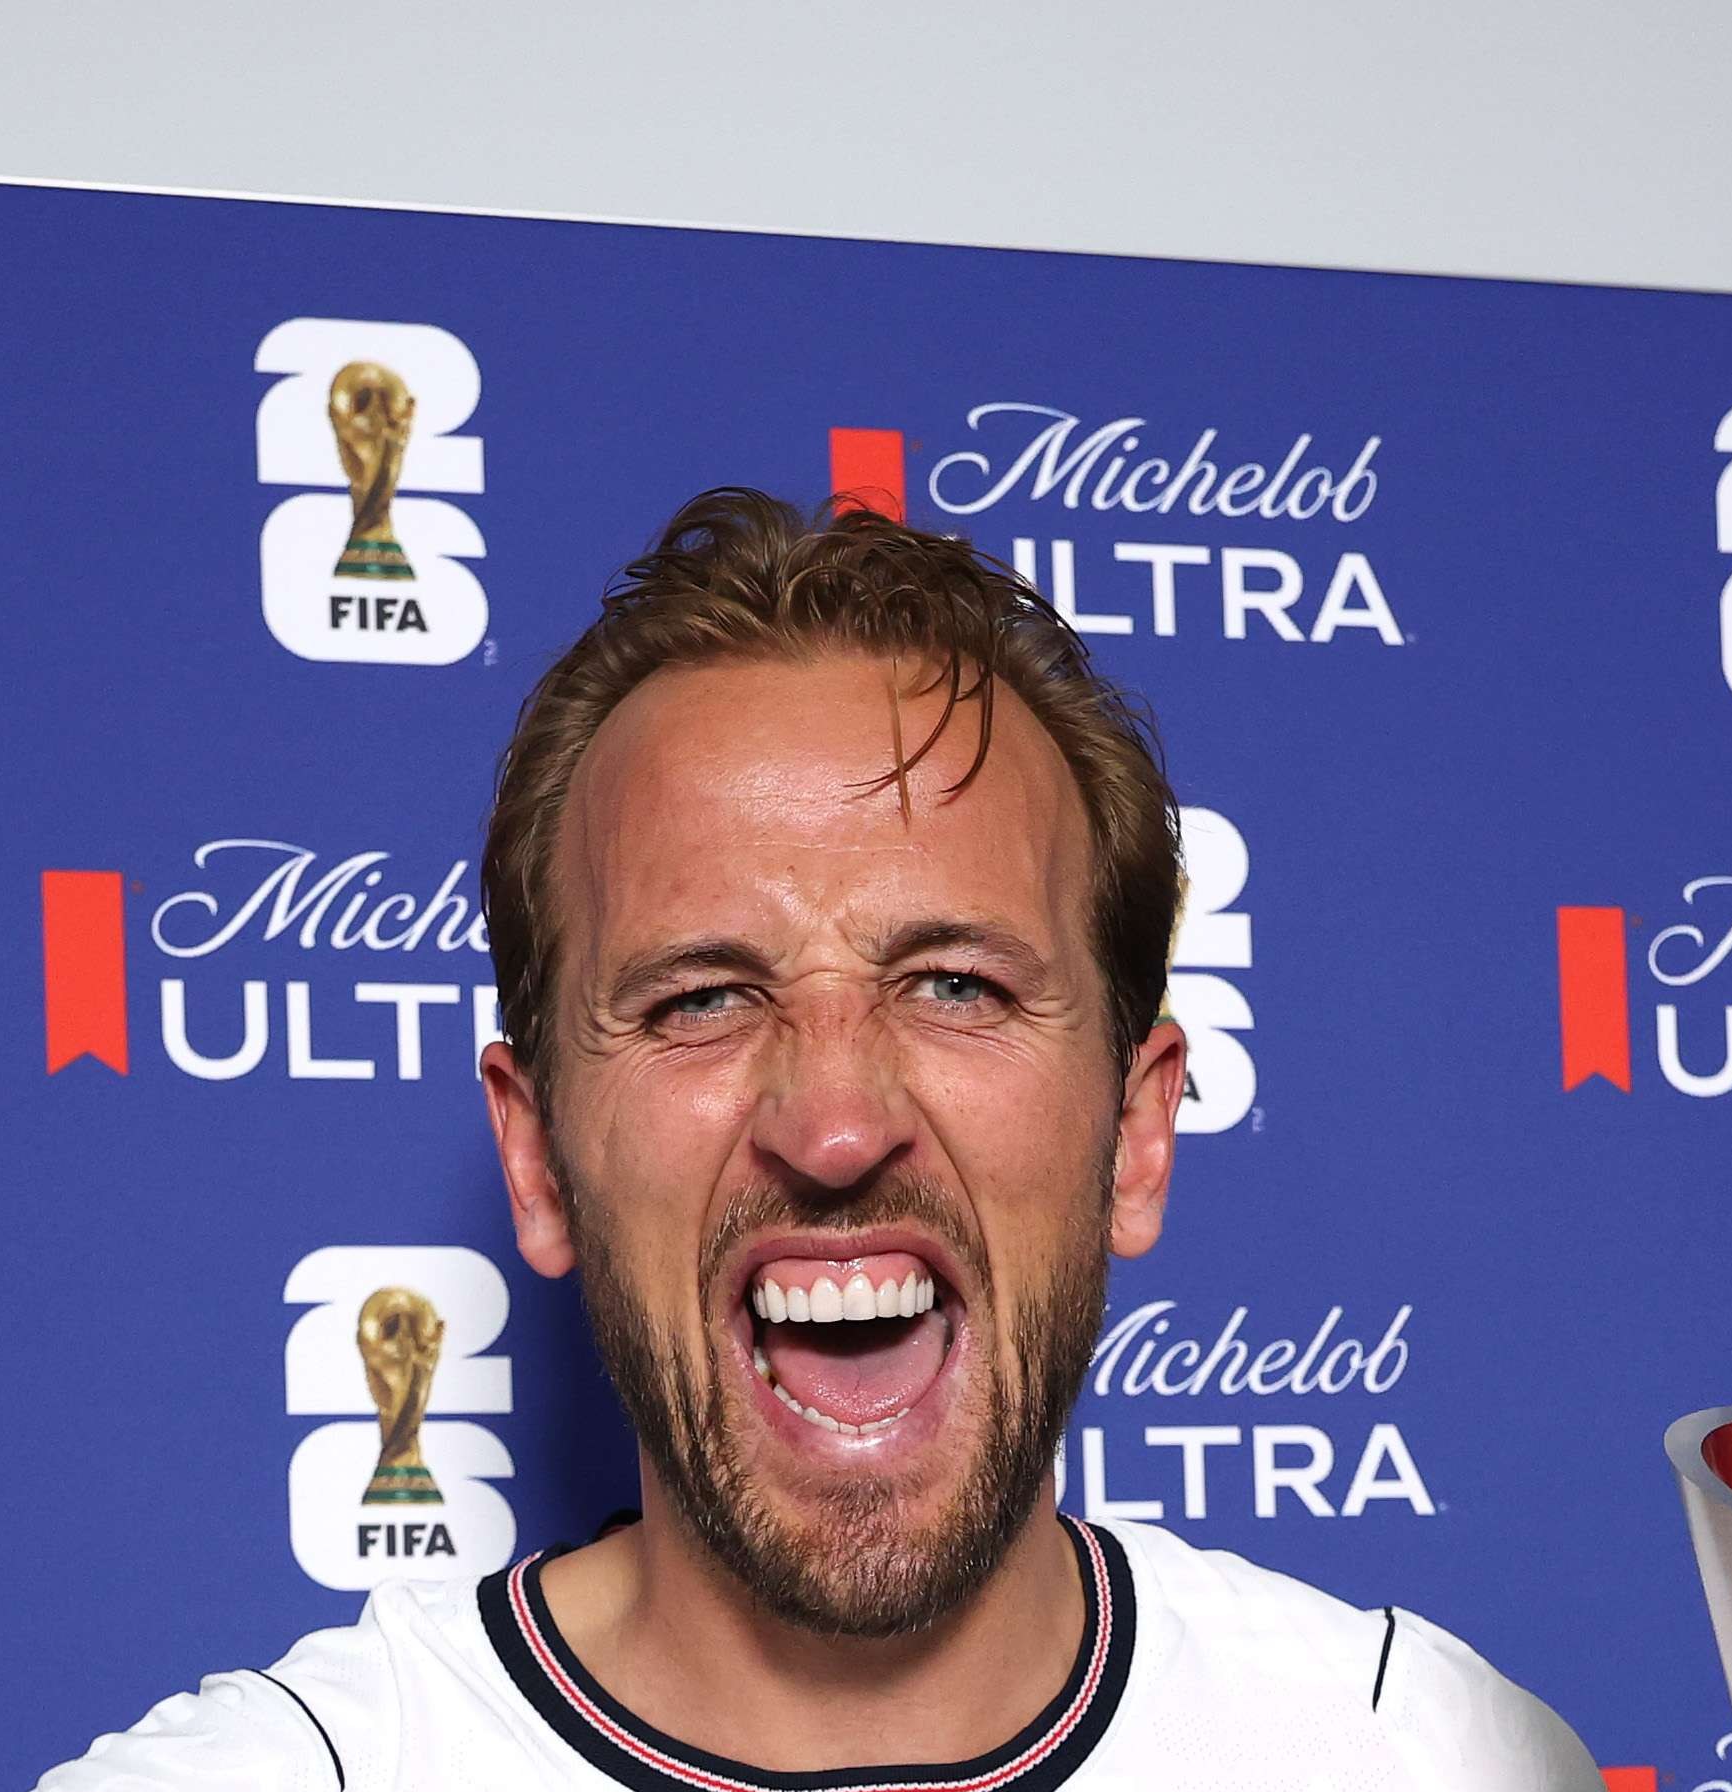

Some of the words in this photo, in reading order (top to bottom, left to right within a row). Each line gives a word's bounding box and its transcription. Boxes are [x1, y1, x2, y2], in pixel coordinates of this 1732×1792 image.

[928, 402, 1381, 522] Michelob
[329, 594, 429, 634] FIFA
[1054, 1422, 1436, 1520] LTRA
[356, 1522, 458, 1559] FIFA
